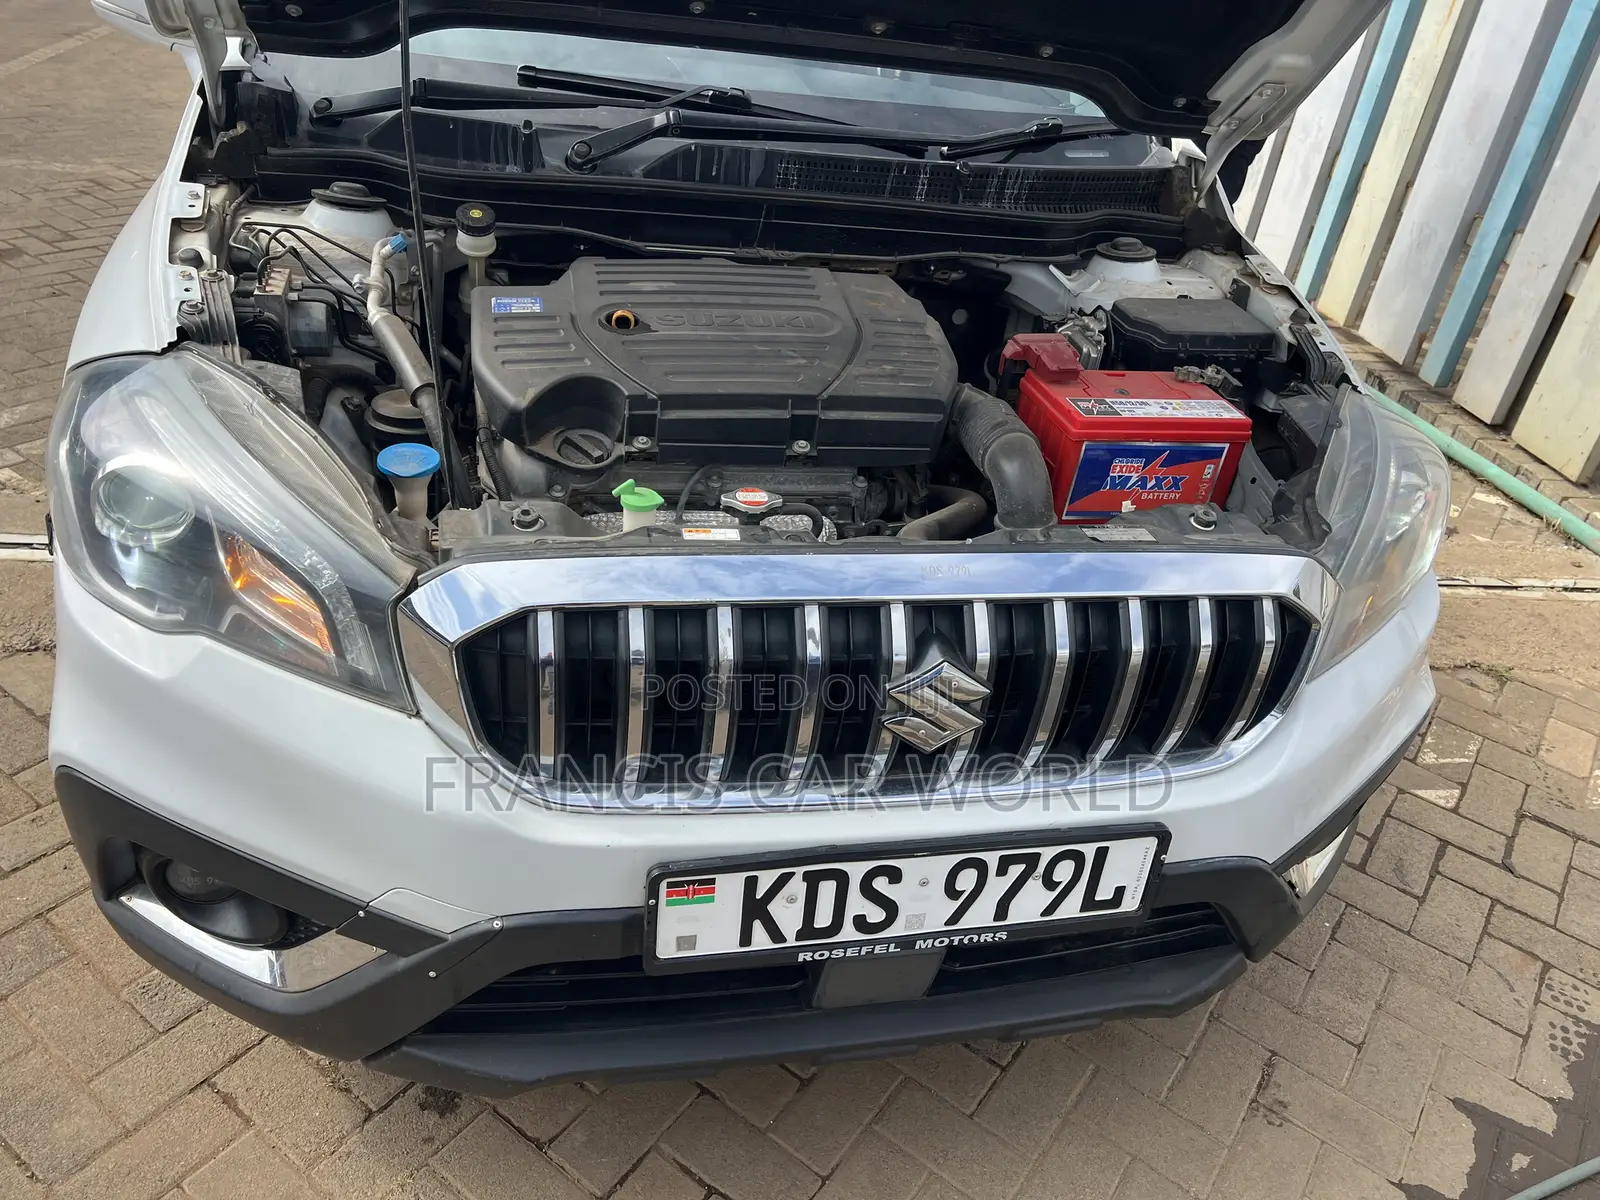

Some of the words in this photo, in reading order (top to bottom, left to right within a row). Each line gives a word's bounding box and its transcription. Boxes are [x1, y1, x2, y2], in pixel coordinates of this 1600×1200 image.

[655, 311, 816, 329] SUZUKI
[1110, 464, 1143, 475] EXIDE
[1101, 474, 1189, 491] MAXX
[1141, 492, 1182, 500] BATTERY
[738, 864, 903, 948] KDS
[943, 845, 1127, 927] 979L
[797, 943, 901, 962] ROSEFEL
[914, 931, 1008, 950] MOTORS
